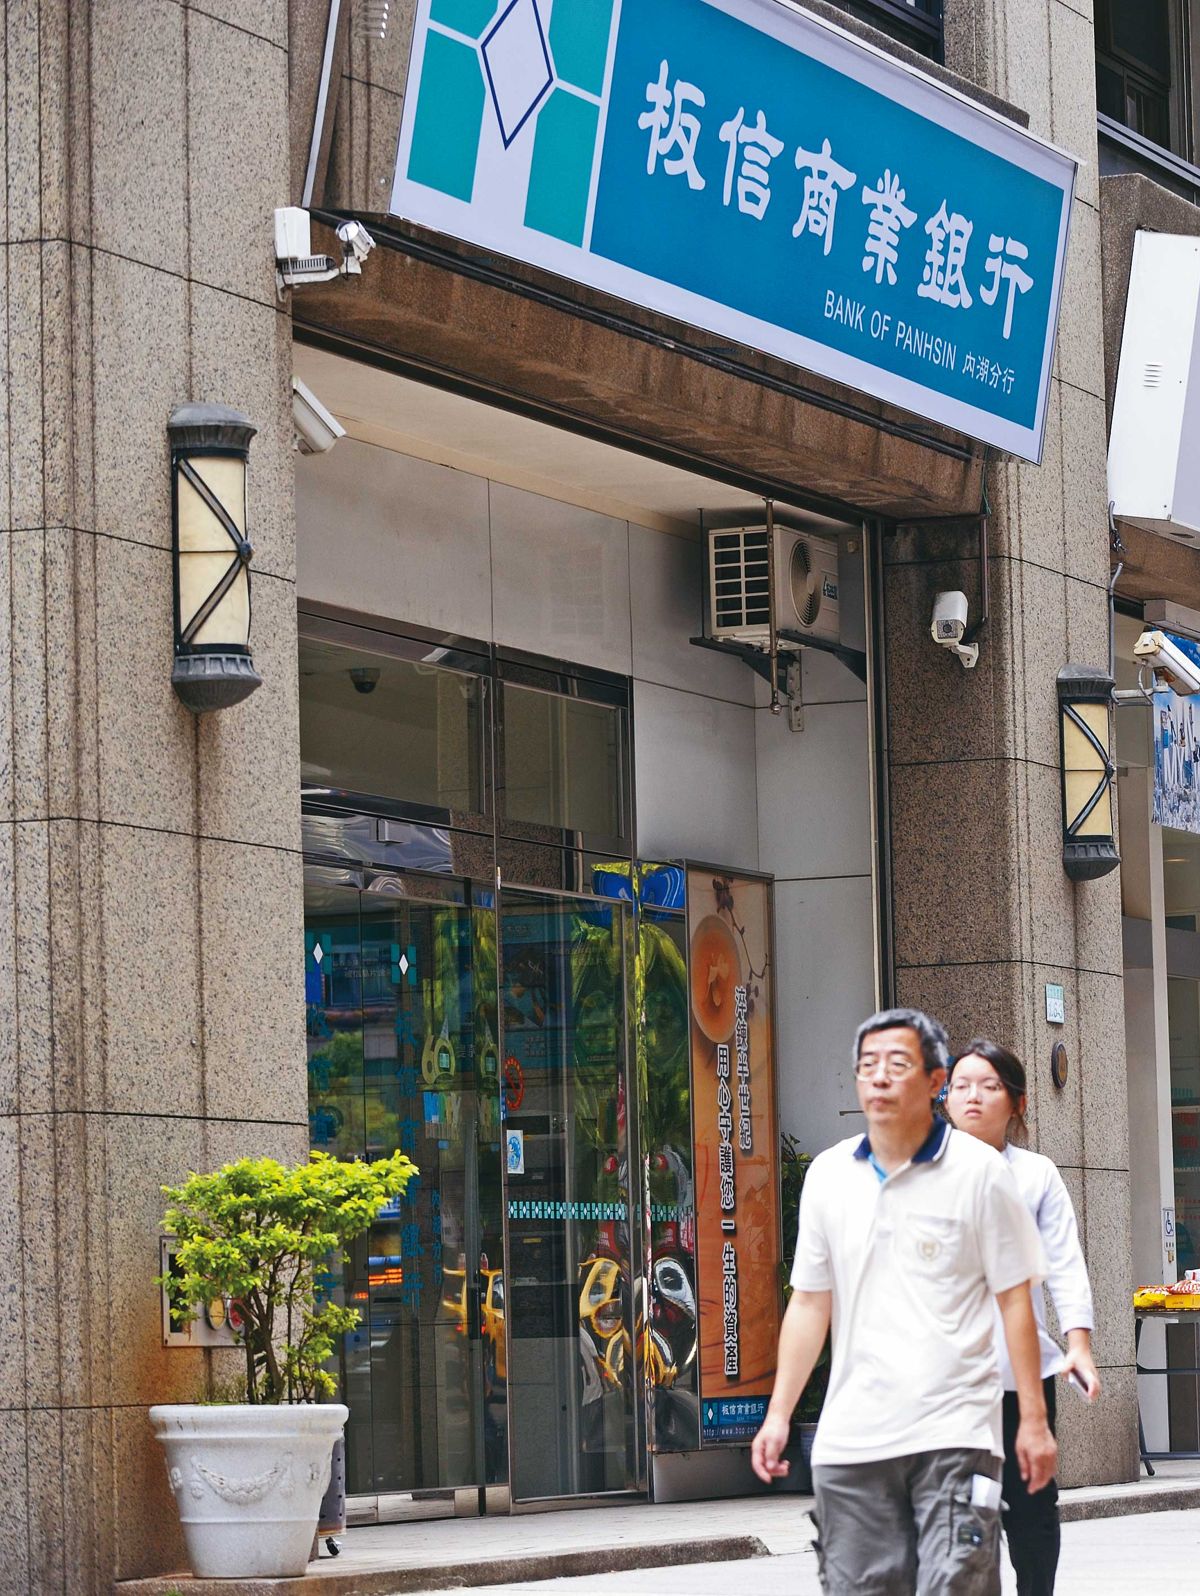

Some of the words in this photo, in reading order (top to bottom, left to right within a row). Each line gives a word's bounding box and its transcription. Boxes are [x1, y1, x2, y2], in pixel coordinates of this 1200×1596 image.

[638, 59, 1034, 340] 板信商業銀行
[824, 289, 864, 333] BANK
[870, 308, 891, 342] OF
[896, 313, 957, 371] PANHSIN
[962, 350, 1016, 395] 內湖分行
[717, 1044, 739, 1376] 用心守護您一生的資產
